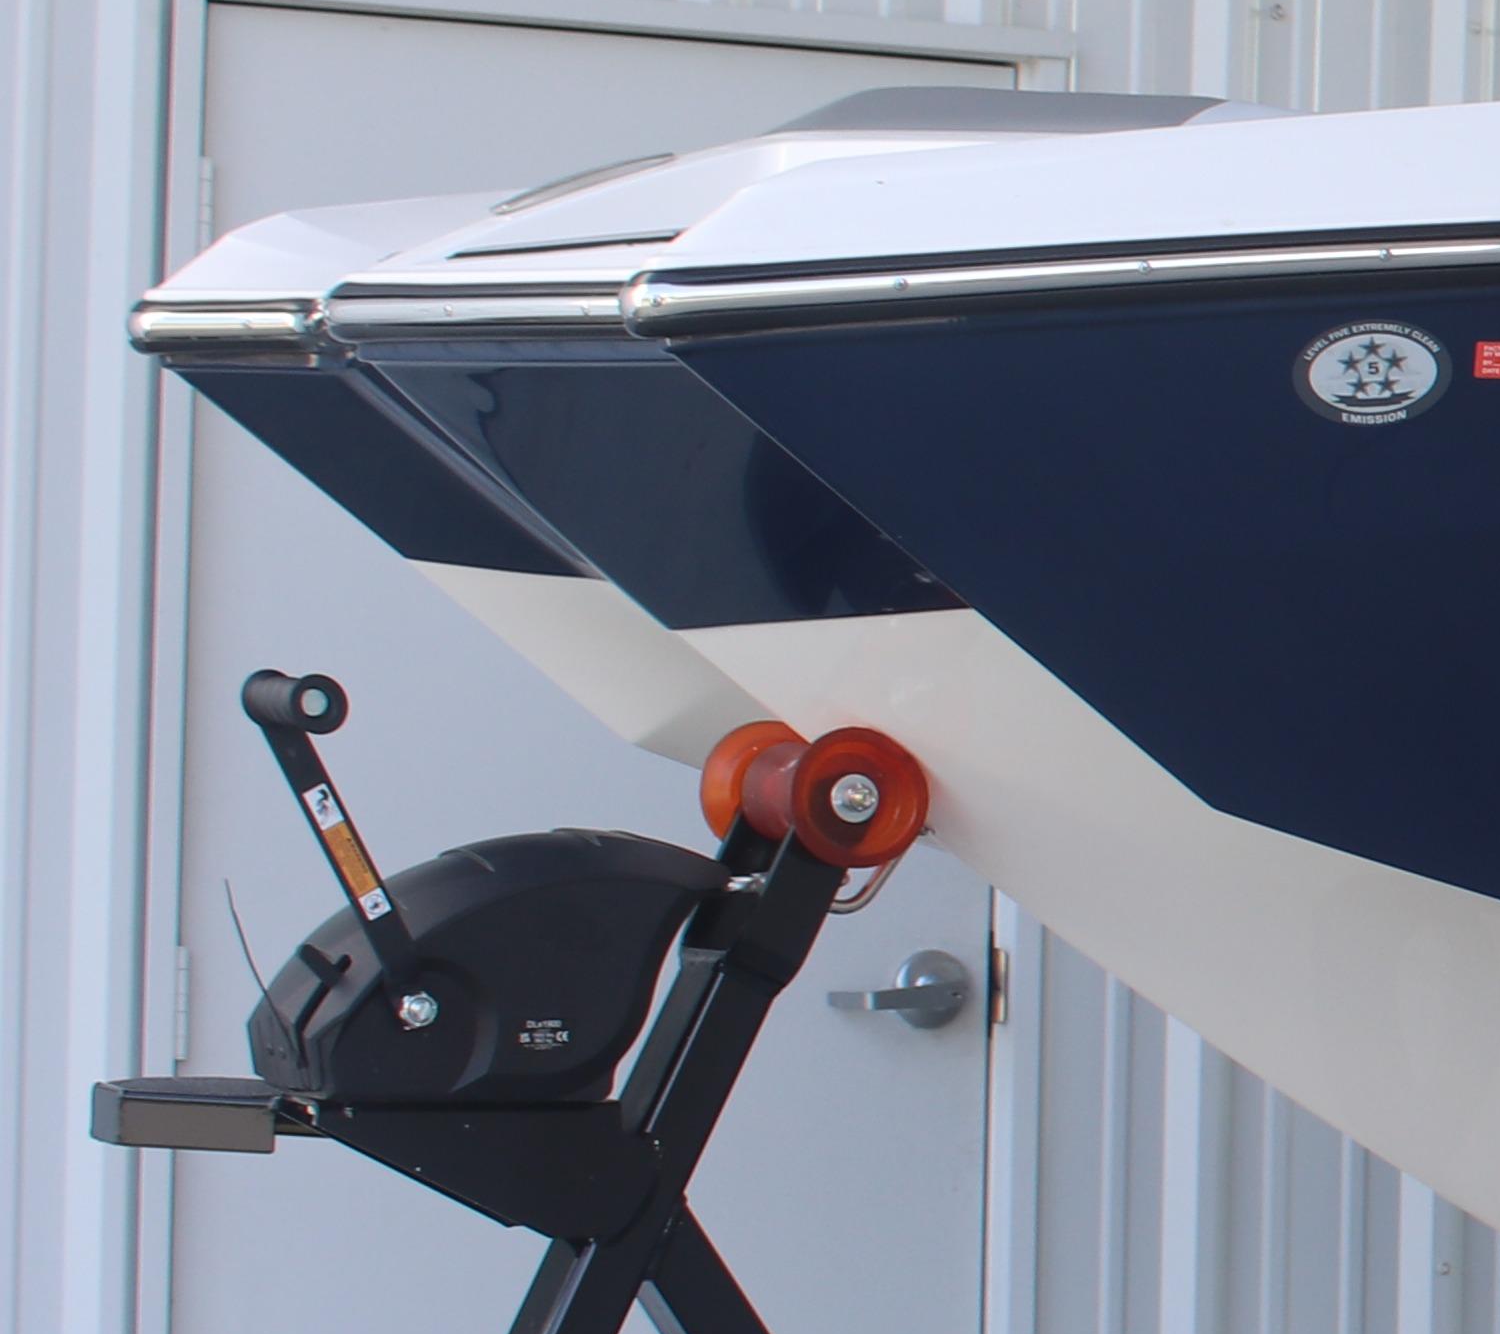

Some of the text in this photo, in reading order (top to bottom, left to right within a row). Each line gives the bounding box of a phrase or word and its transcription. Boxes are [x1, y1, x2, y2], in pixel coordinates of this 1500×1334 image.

[1303, 323, 1441, 362] LEVEL FIVE EXTREMELY CLEAN
[1367, 361, 1380, 375] 5
[1341, 409, 1408, 425] EMISSION
